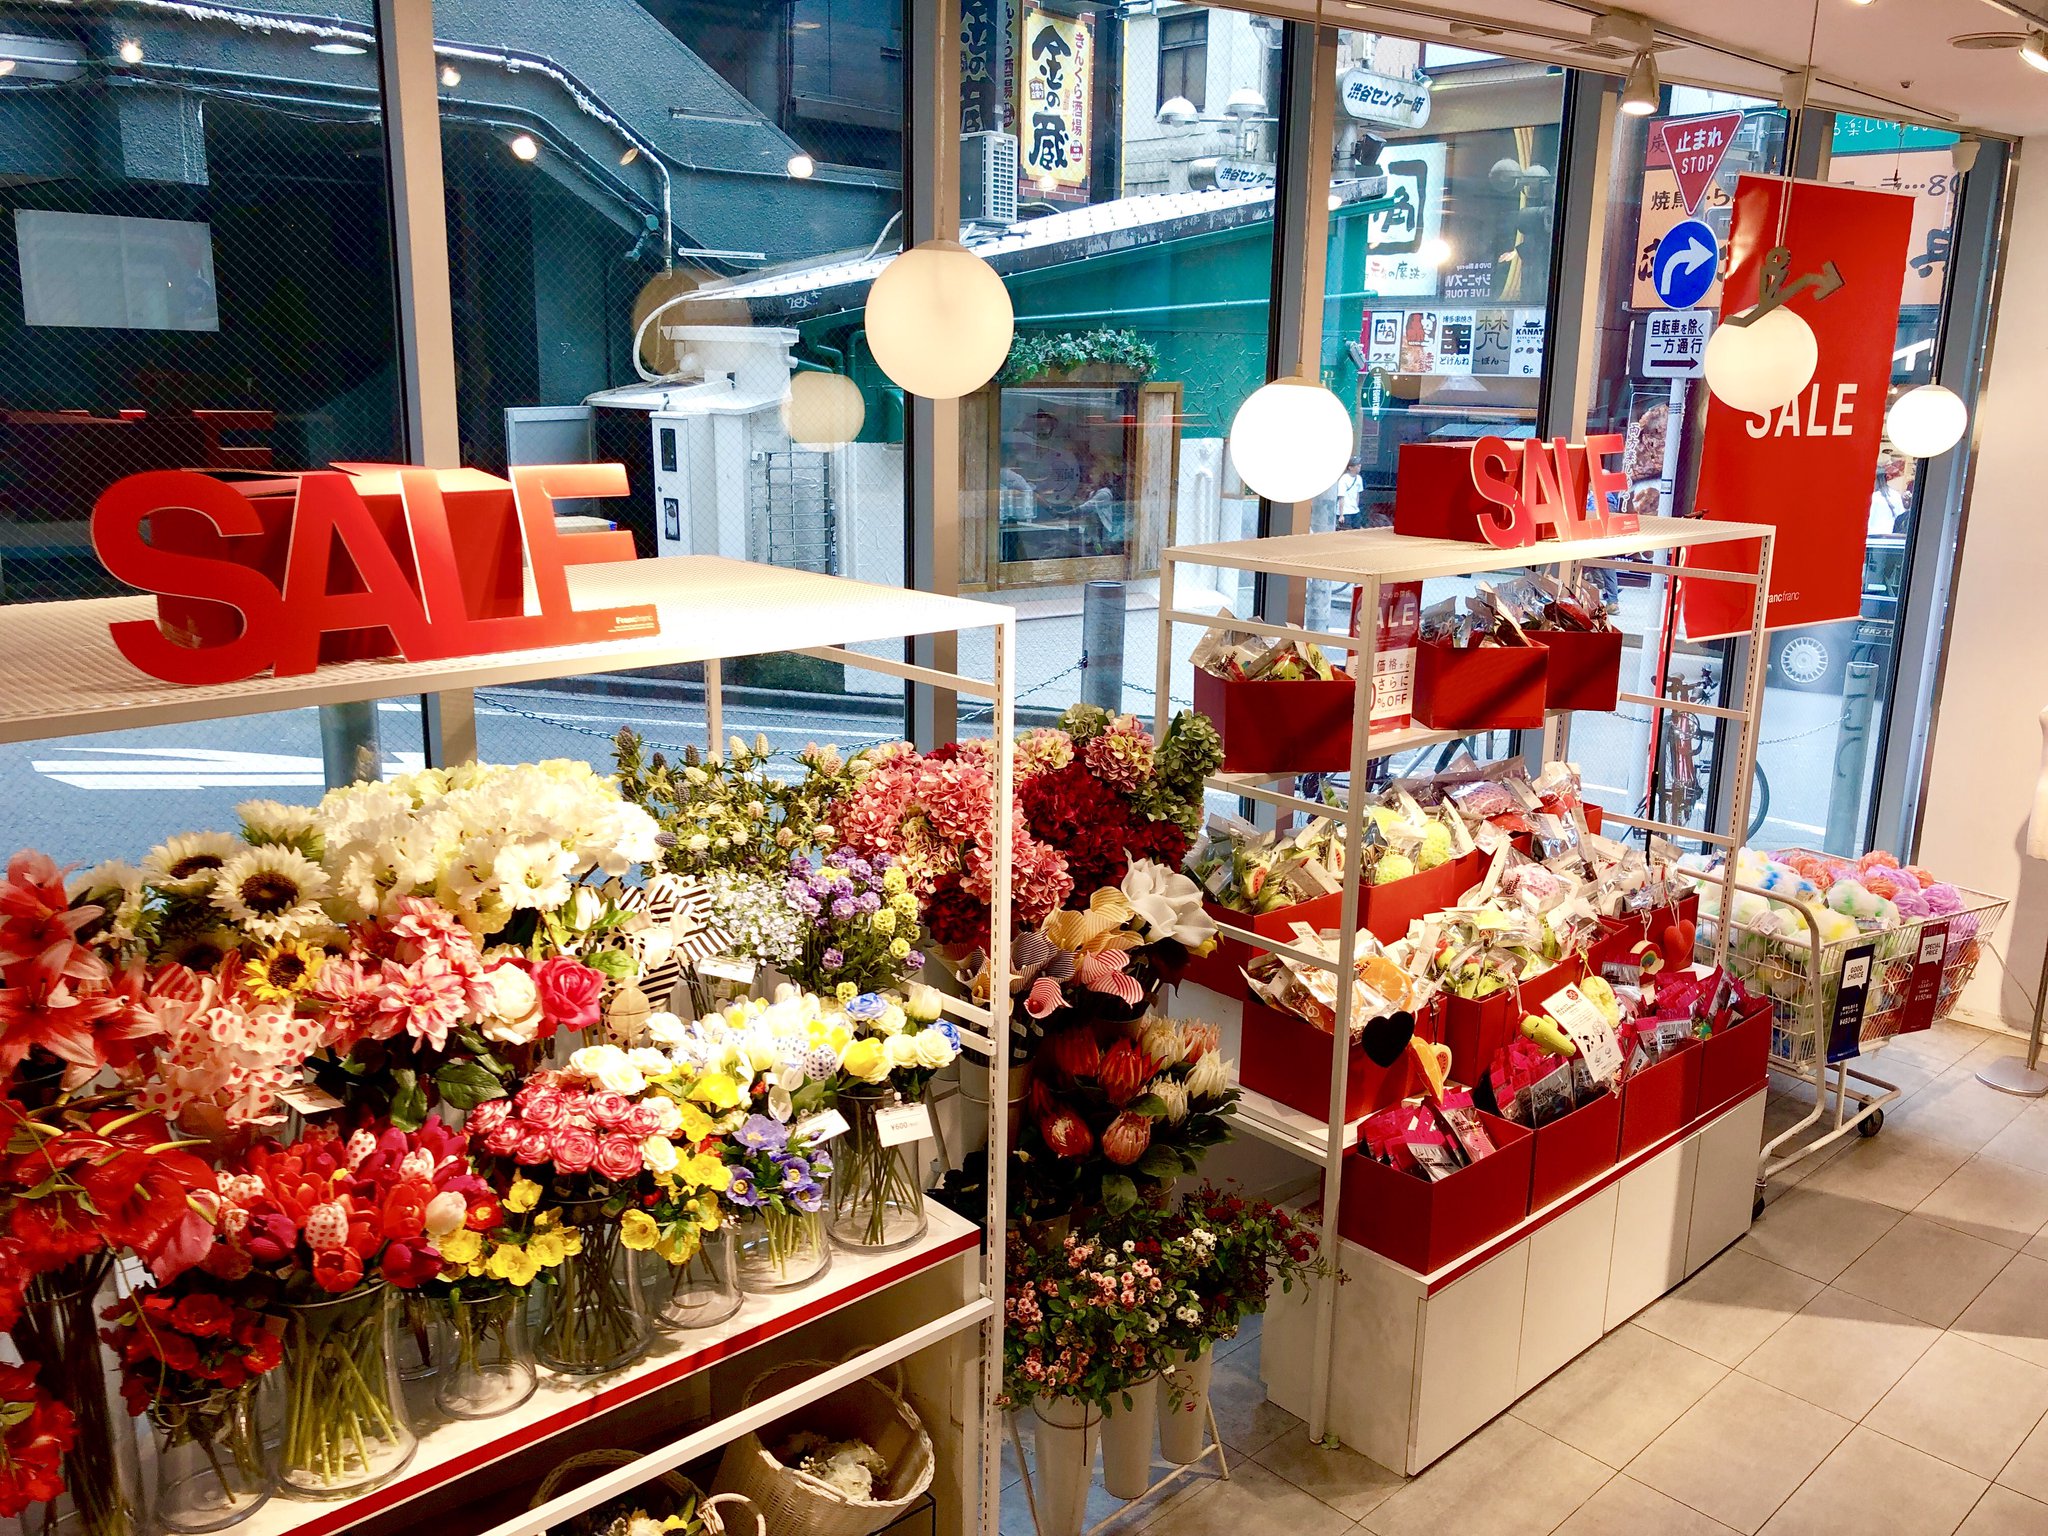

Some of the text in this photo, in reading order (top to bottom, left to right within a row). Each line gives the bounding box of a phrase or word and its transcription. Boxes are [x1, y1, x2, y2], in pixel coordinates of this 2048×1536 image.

[1347, 81, 1426, 114] 渋谷センター街
[1675, 126, 1723, 154] 止まれ
[1220, 166, 1276, 185] 渋谷センター
[1681, 153, 1714, 175] STOP
[1651, 318, 1704, 336] 自転車を除く
[1650, 337, 1703, 355] 一方通行
[1745, 383, 1858, 439] SALE
[1472, 434, 1640, 549] SALE
[90, 462, 661, 685] SALE
[1377, 676, 1409, 692] さらに
